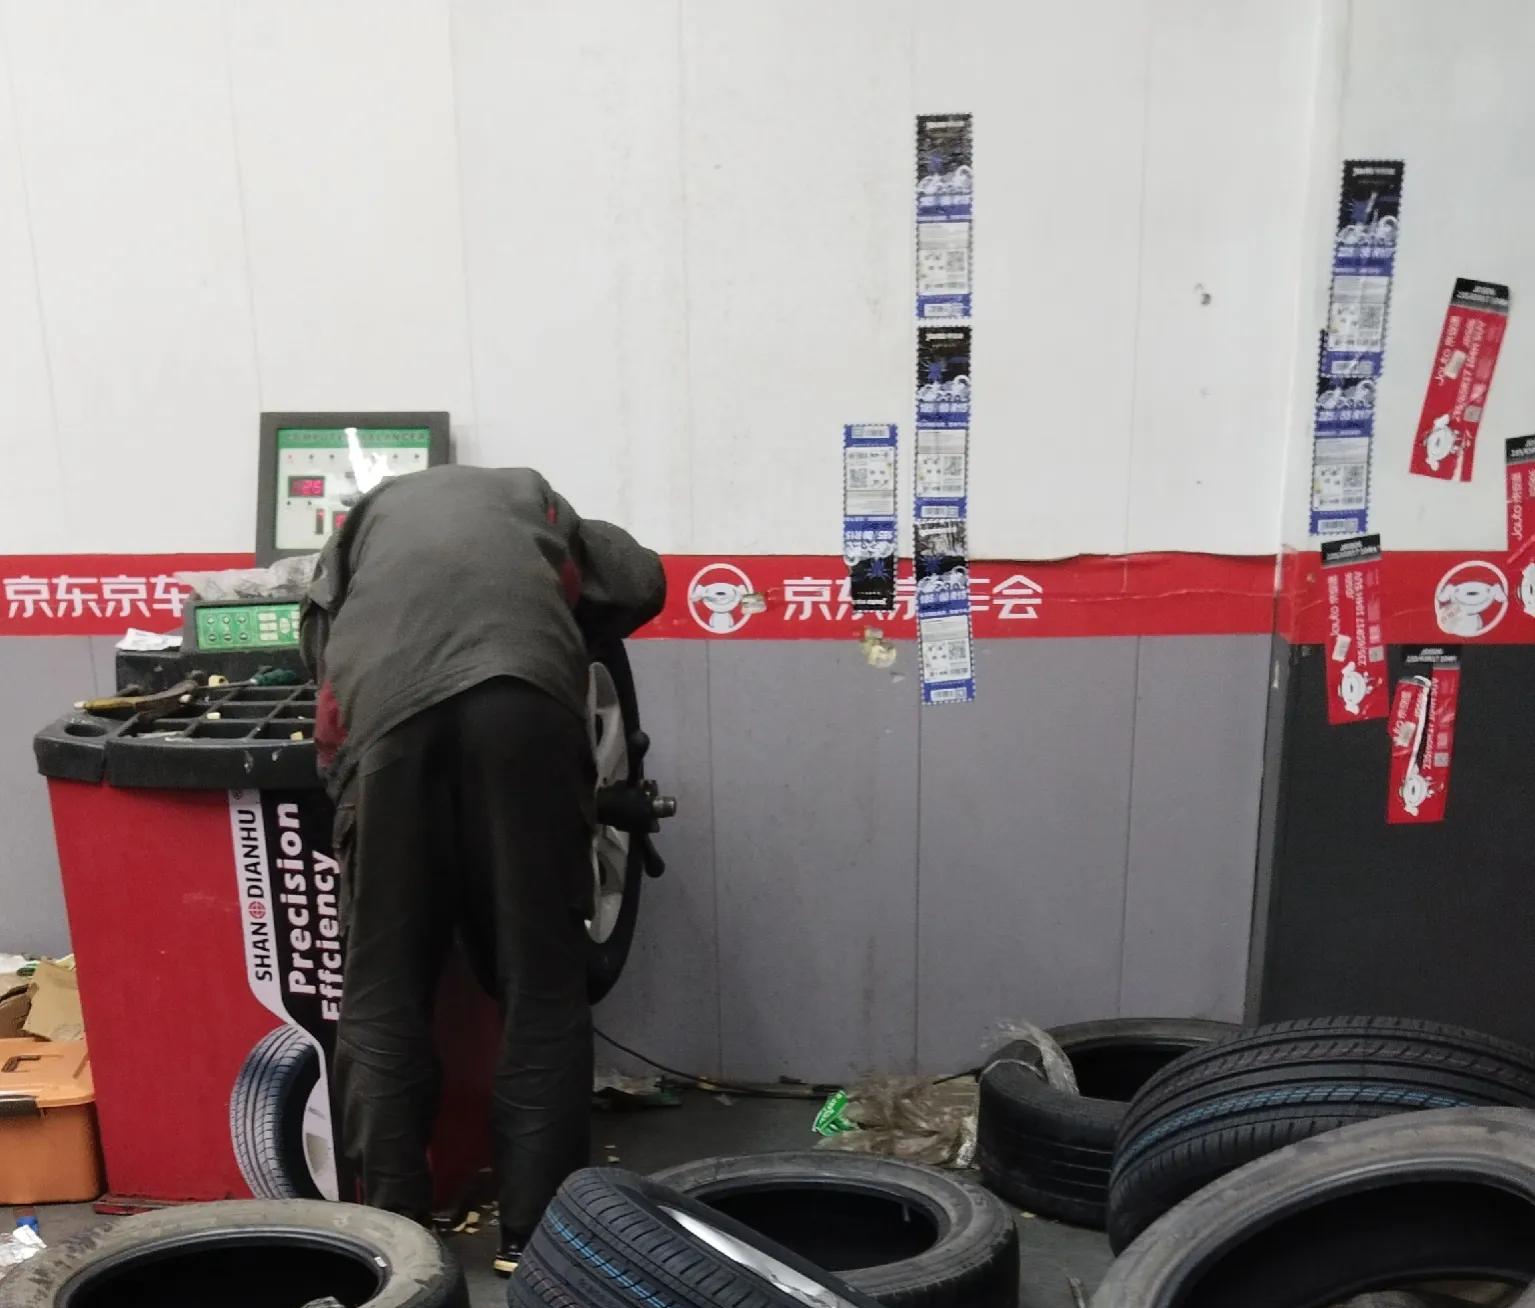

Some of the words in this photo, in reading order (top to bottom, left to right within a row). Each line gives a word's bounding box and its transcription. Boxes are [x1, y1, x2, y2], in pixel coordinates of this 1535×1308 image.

[237, 808, 265, 899] DIANHU
[276, 801, 317, 995] Precision
[254, 921, 273, 983] SHAN
